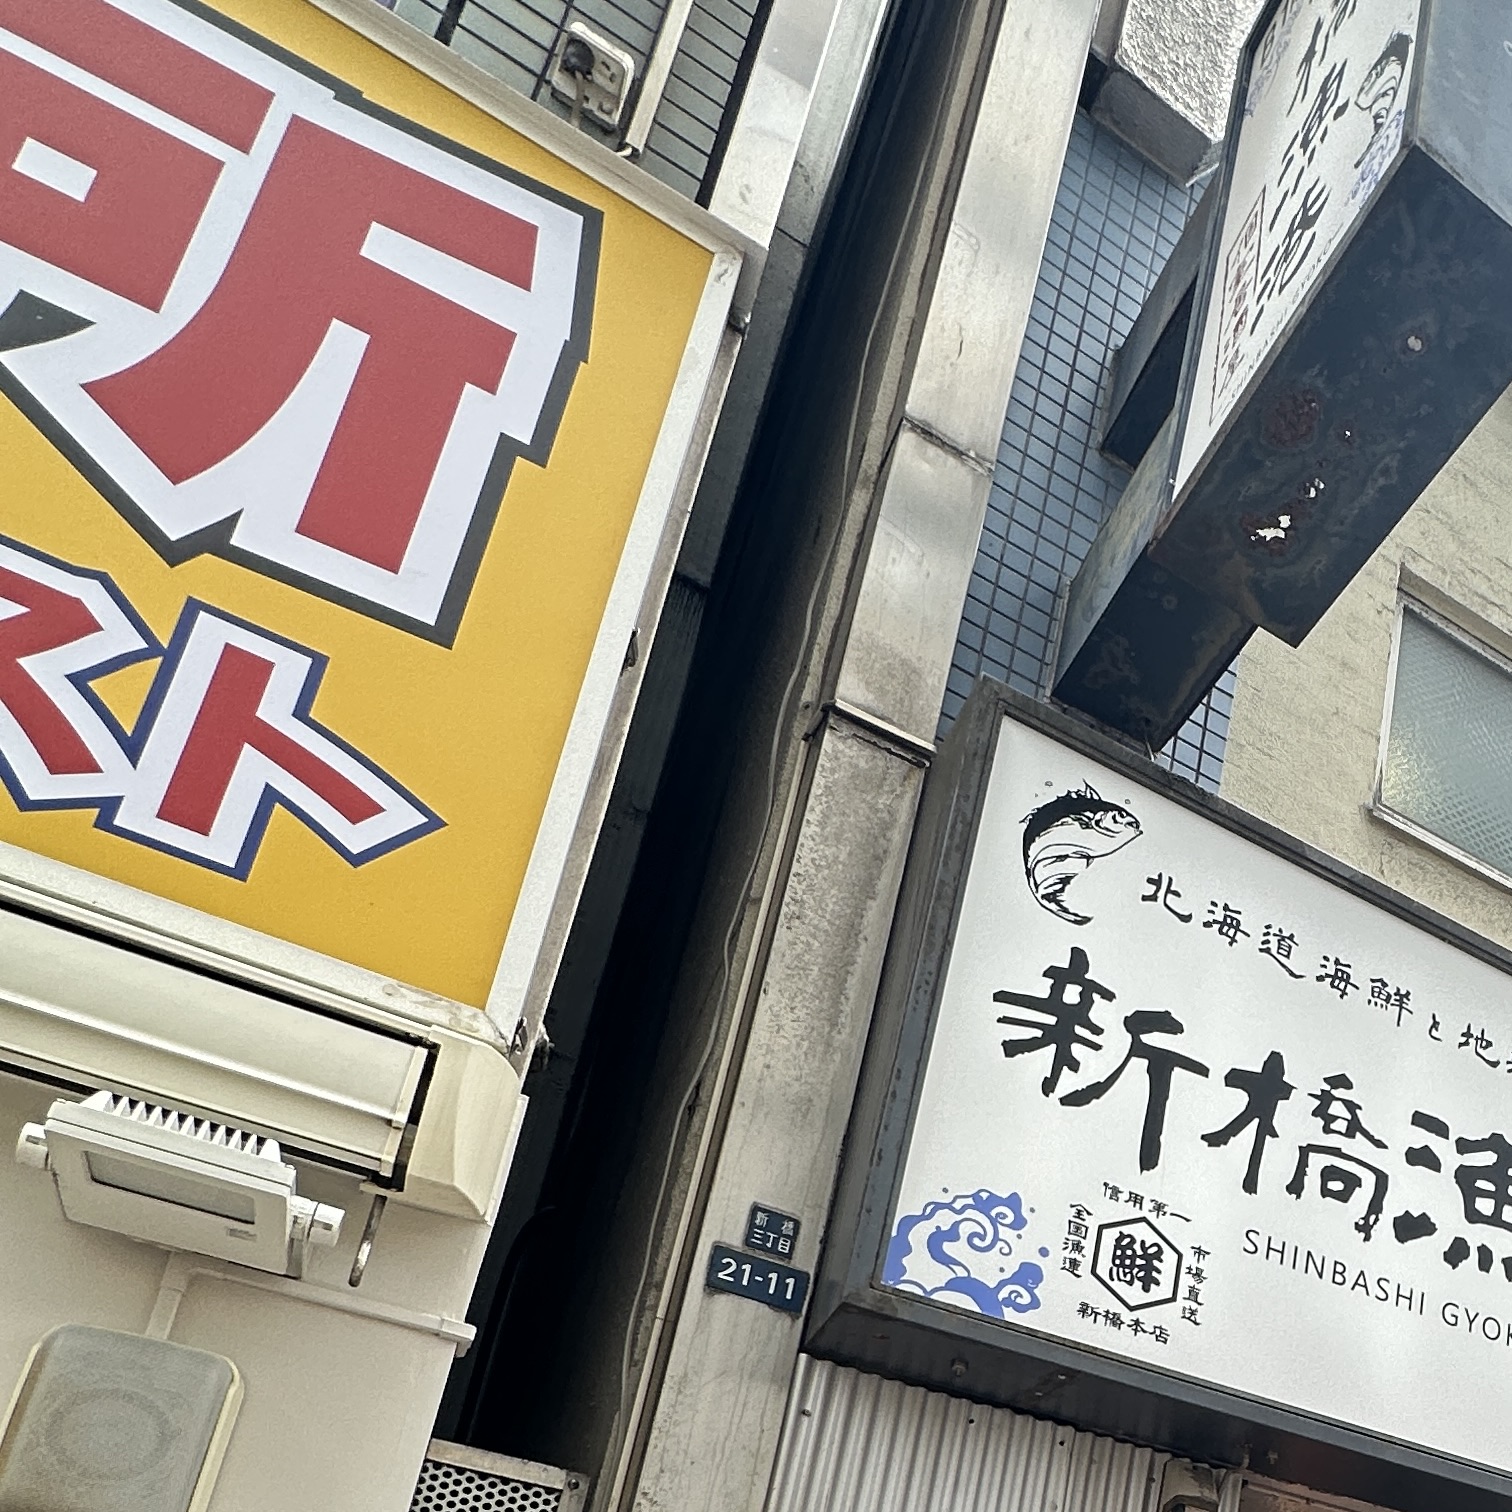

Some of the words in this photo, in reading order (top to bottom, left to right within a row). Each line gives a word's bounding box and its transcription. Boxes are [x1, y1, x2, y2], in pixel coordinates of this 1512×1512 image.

[754, 1211, 795, 1236] 新橋
[1103, 1182, 1192, 1223] 信用第一
[751, 1228, 791, 1254] 三丁目
[1109, 1230, 1164, 1293] 鮮
[717, 1257, 796, 1300] 21-11
[1180, 1245, 1212, 1326] 市場直送
[1242, 1228, 1426, 1317] SHINBASHI
[1076, 1301, 1171, 1345] 新橋本店
